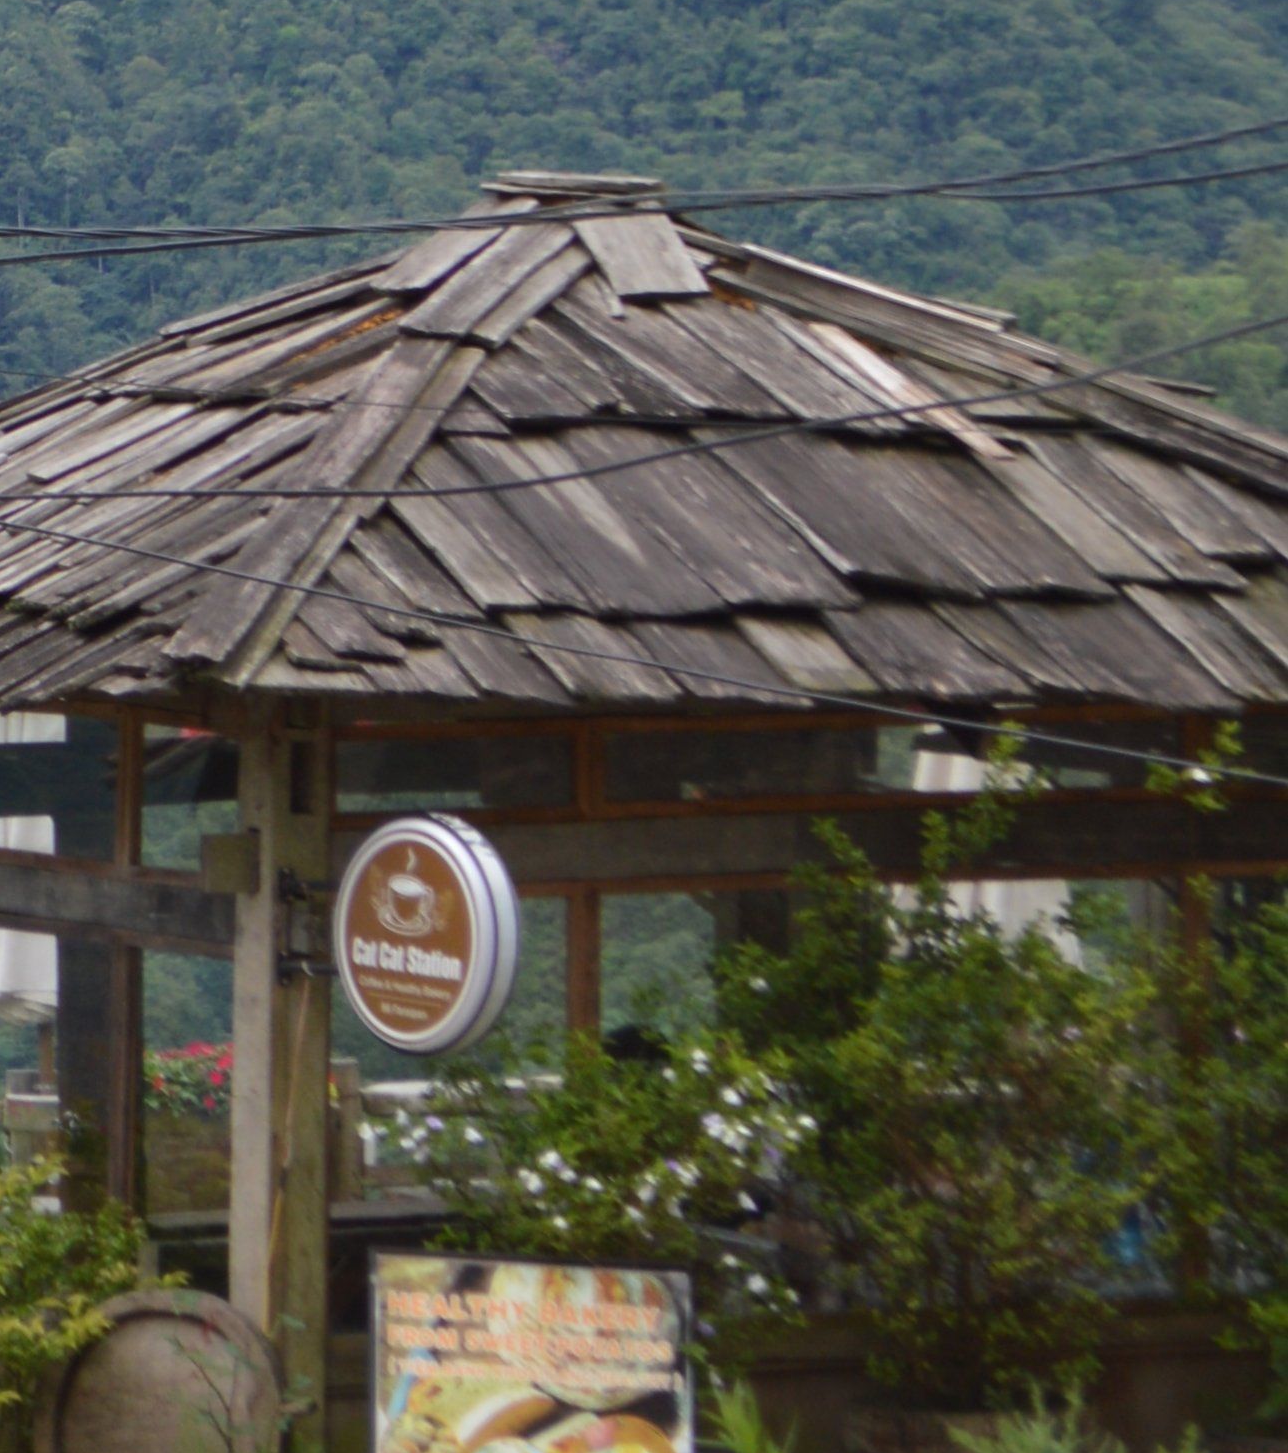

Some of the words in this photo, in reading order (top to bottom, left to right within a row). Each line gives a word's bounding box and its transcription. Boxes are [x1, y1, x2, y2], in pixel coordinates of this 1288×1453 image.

[352, 936, 378, 969] Cat
[379, 941, 404, 973] Cat
[406, 945, 463, 981] Station
[386, 1290, 527, 1322] HEALTHY
[538, 1302, 662, 1333] BAKERY
[386, 1323, 459, 1351] FROM
[464, 1329, 545, 1354] SWEET
